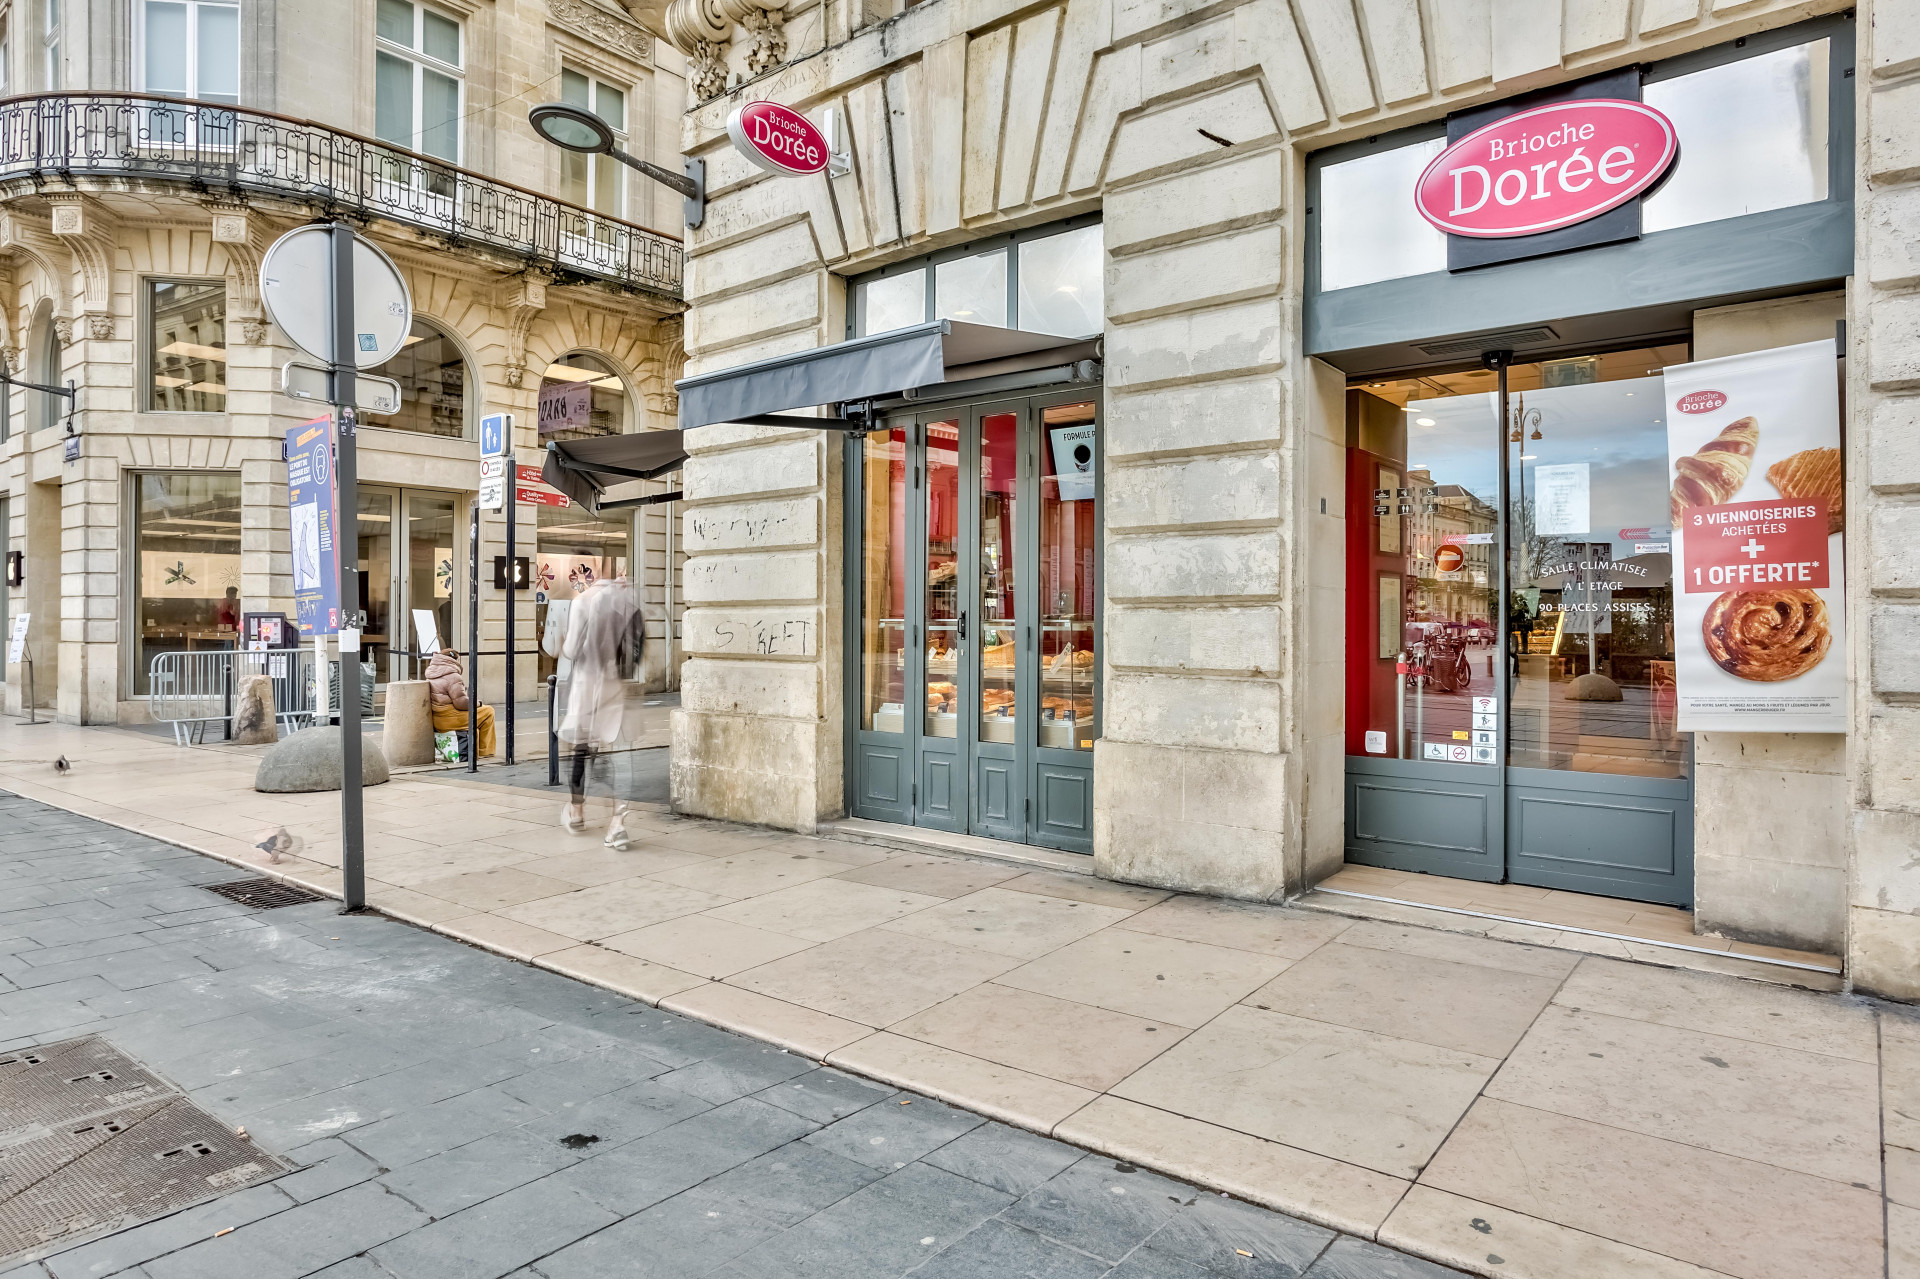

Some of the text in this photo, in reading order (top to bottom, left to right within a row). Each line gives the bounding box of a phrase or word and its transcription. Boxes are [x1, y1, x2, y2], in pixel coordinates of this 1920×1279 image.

[769, 110, 807, 137] Brioche
[753, 114, 819, 166] Dorée
[1489, 122, 1595, 162] Brioche
[1448, 145, 1635, 217] Dorée
[1682, 398, 1722, 412] Dorée
[1685, 392, 1719, 403] Brioche
[1063, 430, 1091, 441] FORMULE
[1693, 505, 1816, 526] 3 VIENNOISERIES
[1721, 522, 1787, 537] ACHETÉES
[1541, 561, 1648, 578] SALLE CLIMATISEE
[1693, 567, 1702, 585] 1
[1564, 582, 1572, 591] A
[1590, 581, 1624, 591] ETAGE
[1538, 602, 1650, 612] 90 PLACES ASSISES
